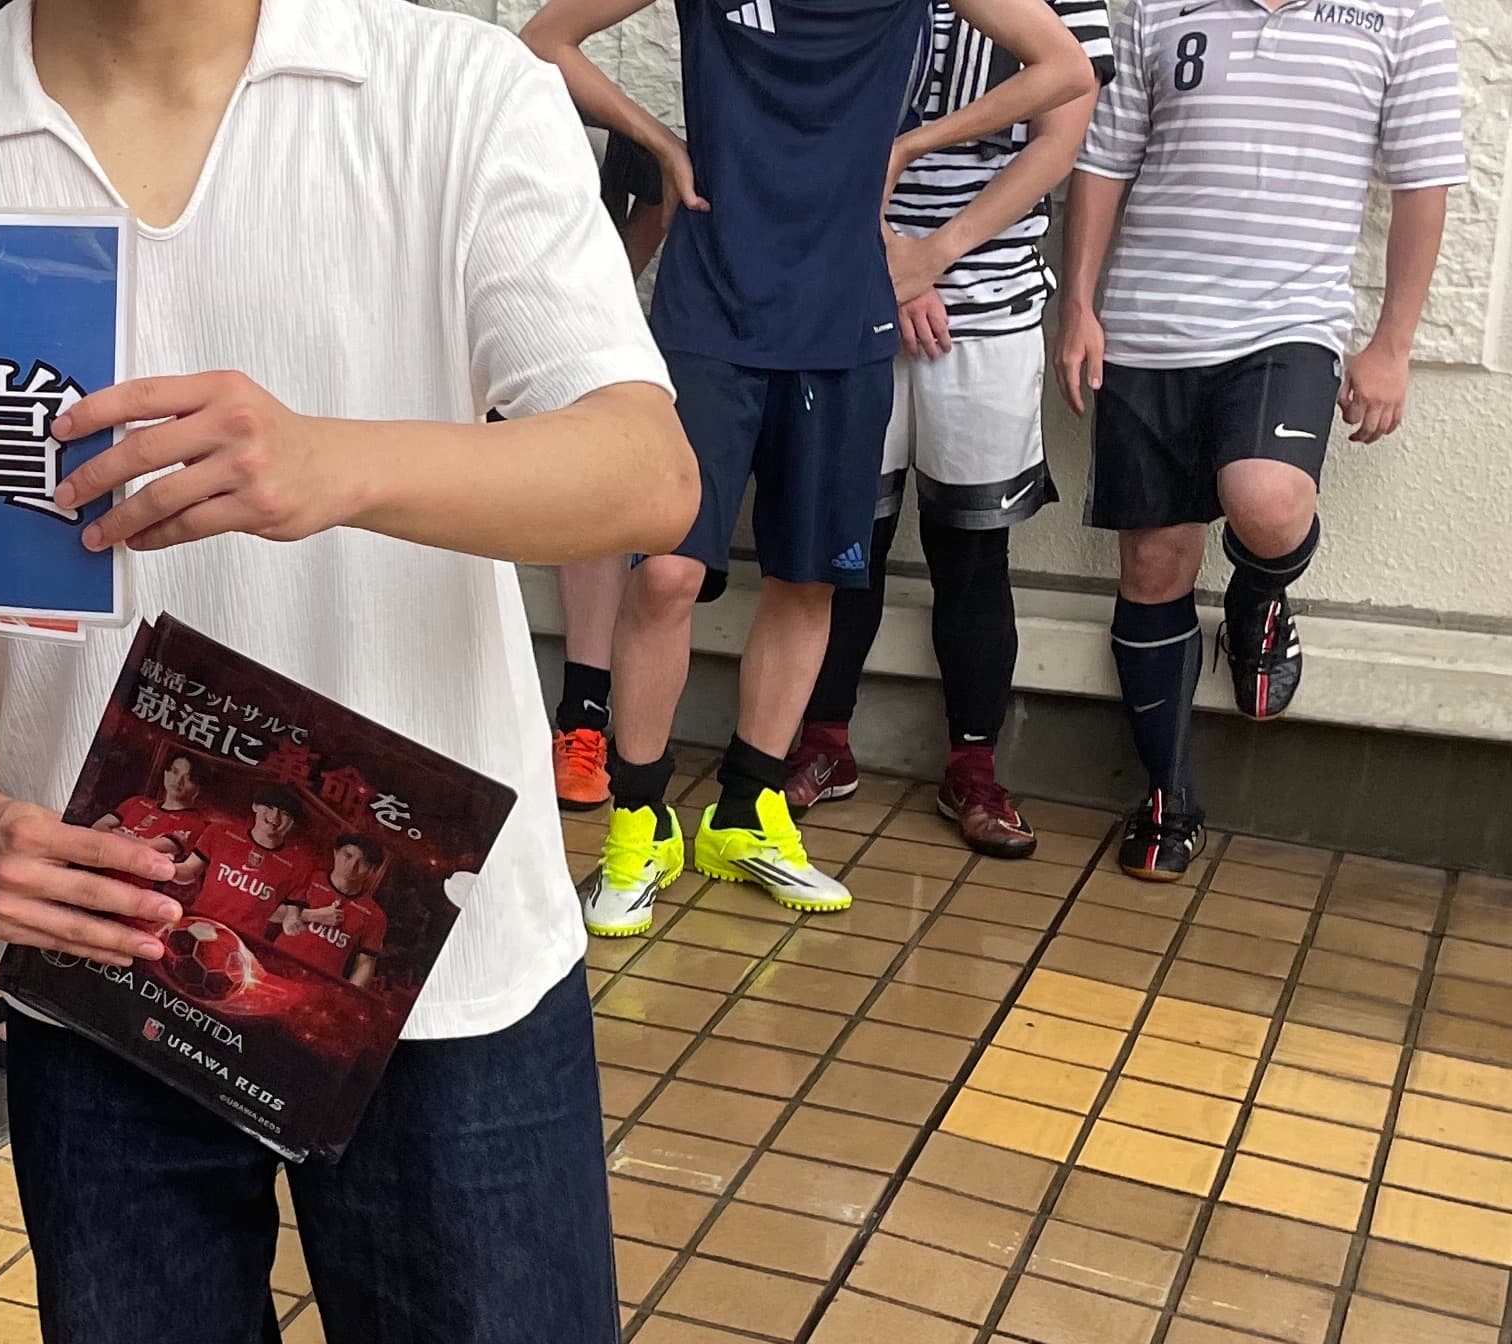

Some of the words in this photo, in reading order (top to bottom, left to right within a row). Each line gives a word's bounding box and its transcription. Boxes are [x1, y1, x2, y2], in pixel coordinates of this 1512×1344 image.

[1174, 31, 1208, 92] 8
[139, 657, 310, 745] 就活フットサルで
[216, 862, 276, 902] POLUS
[307, 919, 352, 950] OLUS
[167, 1034, 229, 1081] URAWA
[235, 1075, 286, 1112] REDS
[257, 1115, 282, 1135] REDS
